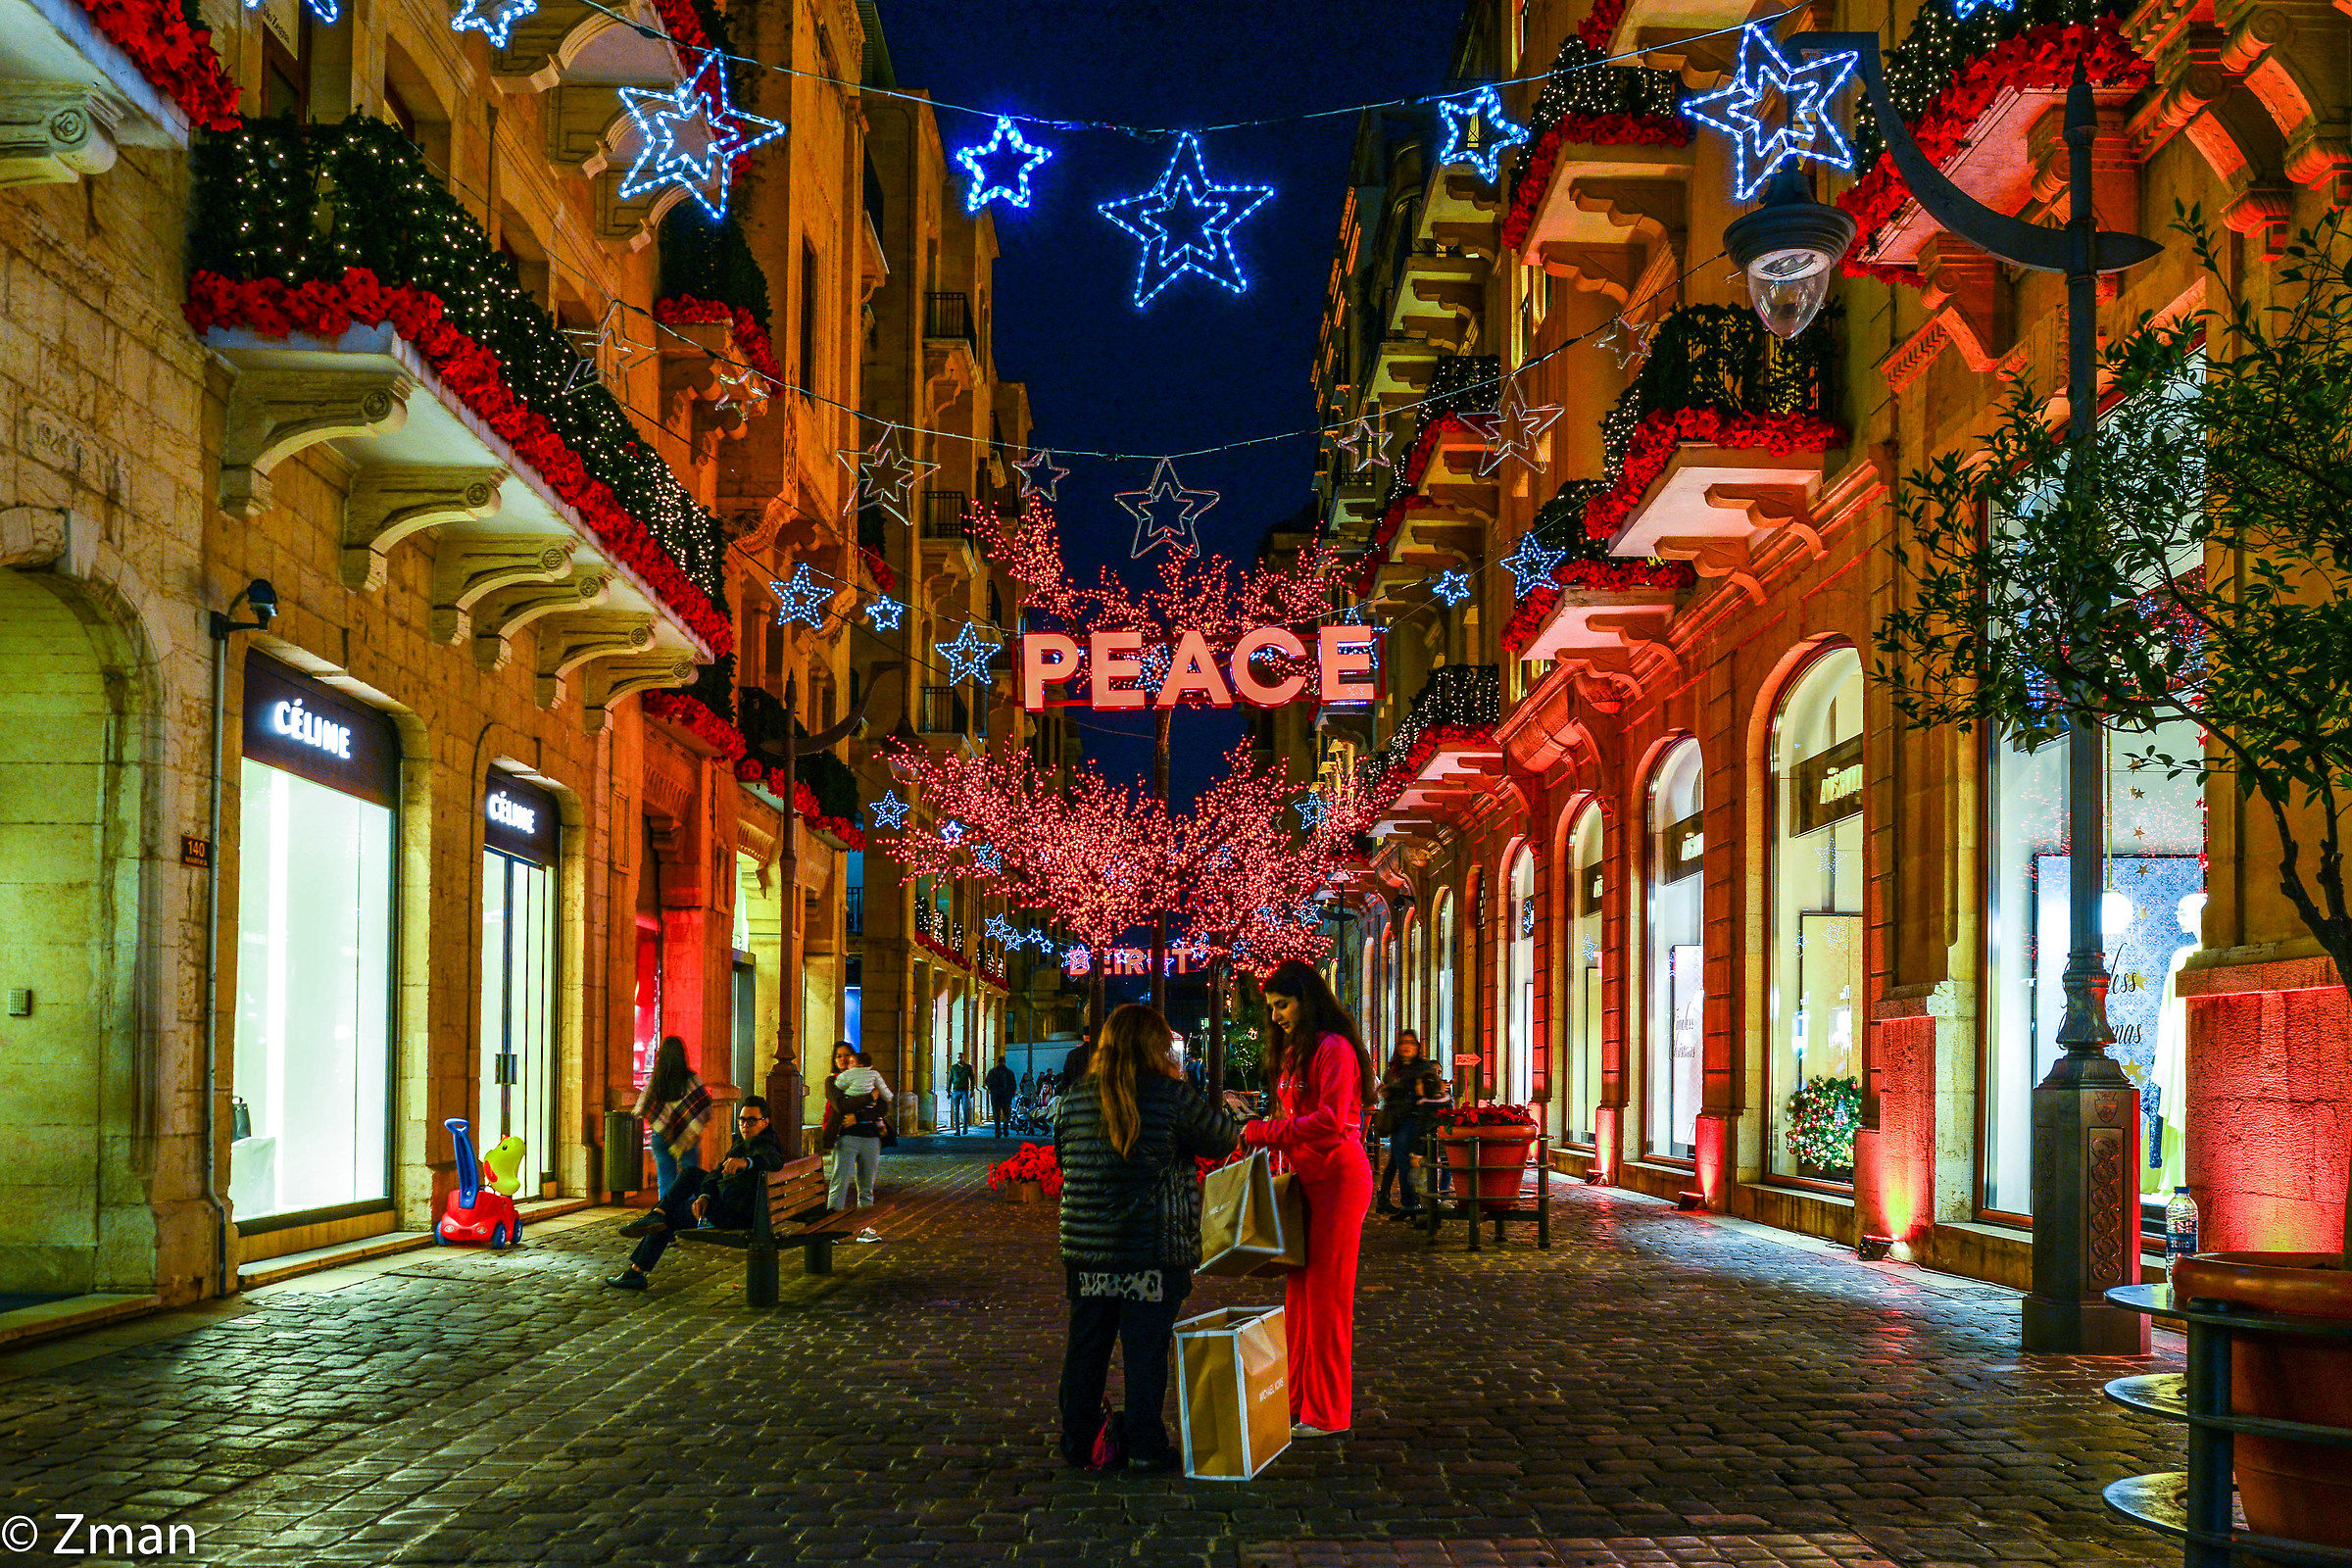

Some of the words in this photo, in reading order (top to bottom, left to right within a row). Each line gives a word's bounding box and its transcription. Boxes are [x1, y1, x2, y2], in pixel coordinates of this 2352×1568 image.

[1024, 626, 1374, 711] PEACE
[274, 698, 351, 759] CÉLINE
[489, 791, 535, 834] CÉLINE
[188, 841, 205, 858] 140
